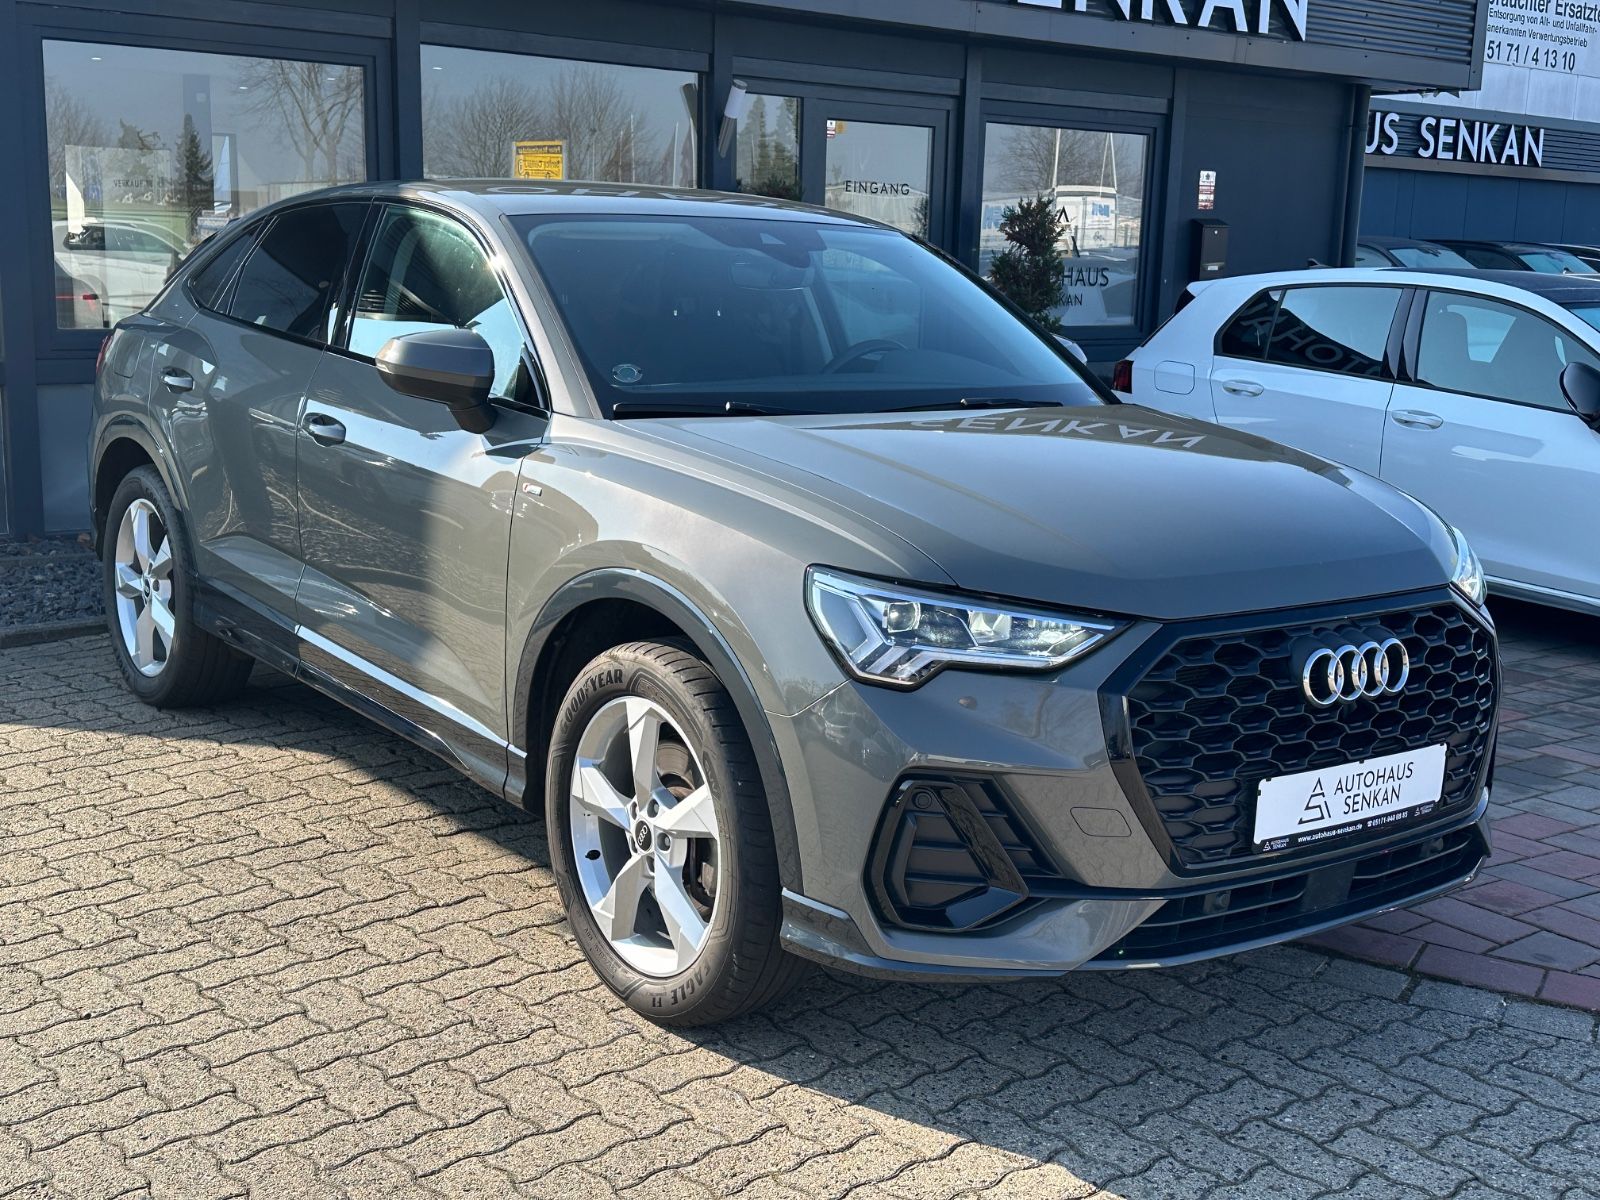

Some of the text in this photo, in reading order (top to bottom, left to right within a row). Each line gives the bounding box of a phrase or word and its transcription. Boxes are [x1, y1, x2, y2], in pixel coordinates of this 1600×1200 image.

[1489, 8, 1525, 25] Entsorgung
[1527, 15, 1538, 24] von
[1552, 20, 1565, 29] und
[1487, 40, 1501, 60] 51
[1507, 42, 1520, 63] 71
[1532, 46, 1540, 65] 4
[1544, 48, 1558, 69] 13
[1562, 51, 1576, 72] 10
[1365, 111, 1545, 168] US SENKAN
[845, 181, 910, 195] EINGANG
[1061, 266, 1110, 287] HAUS
[560, 668, 623, 735] GOODYEAR
[1334, 761, 1414, 796] AUTOHAUS
[1343, 783, 1401, 815] SENKAN
